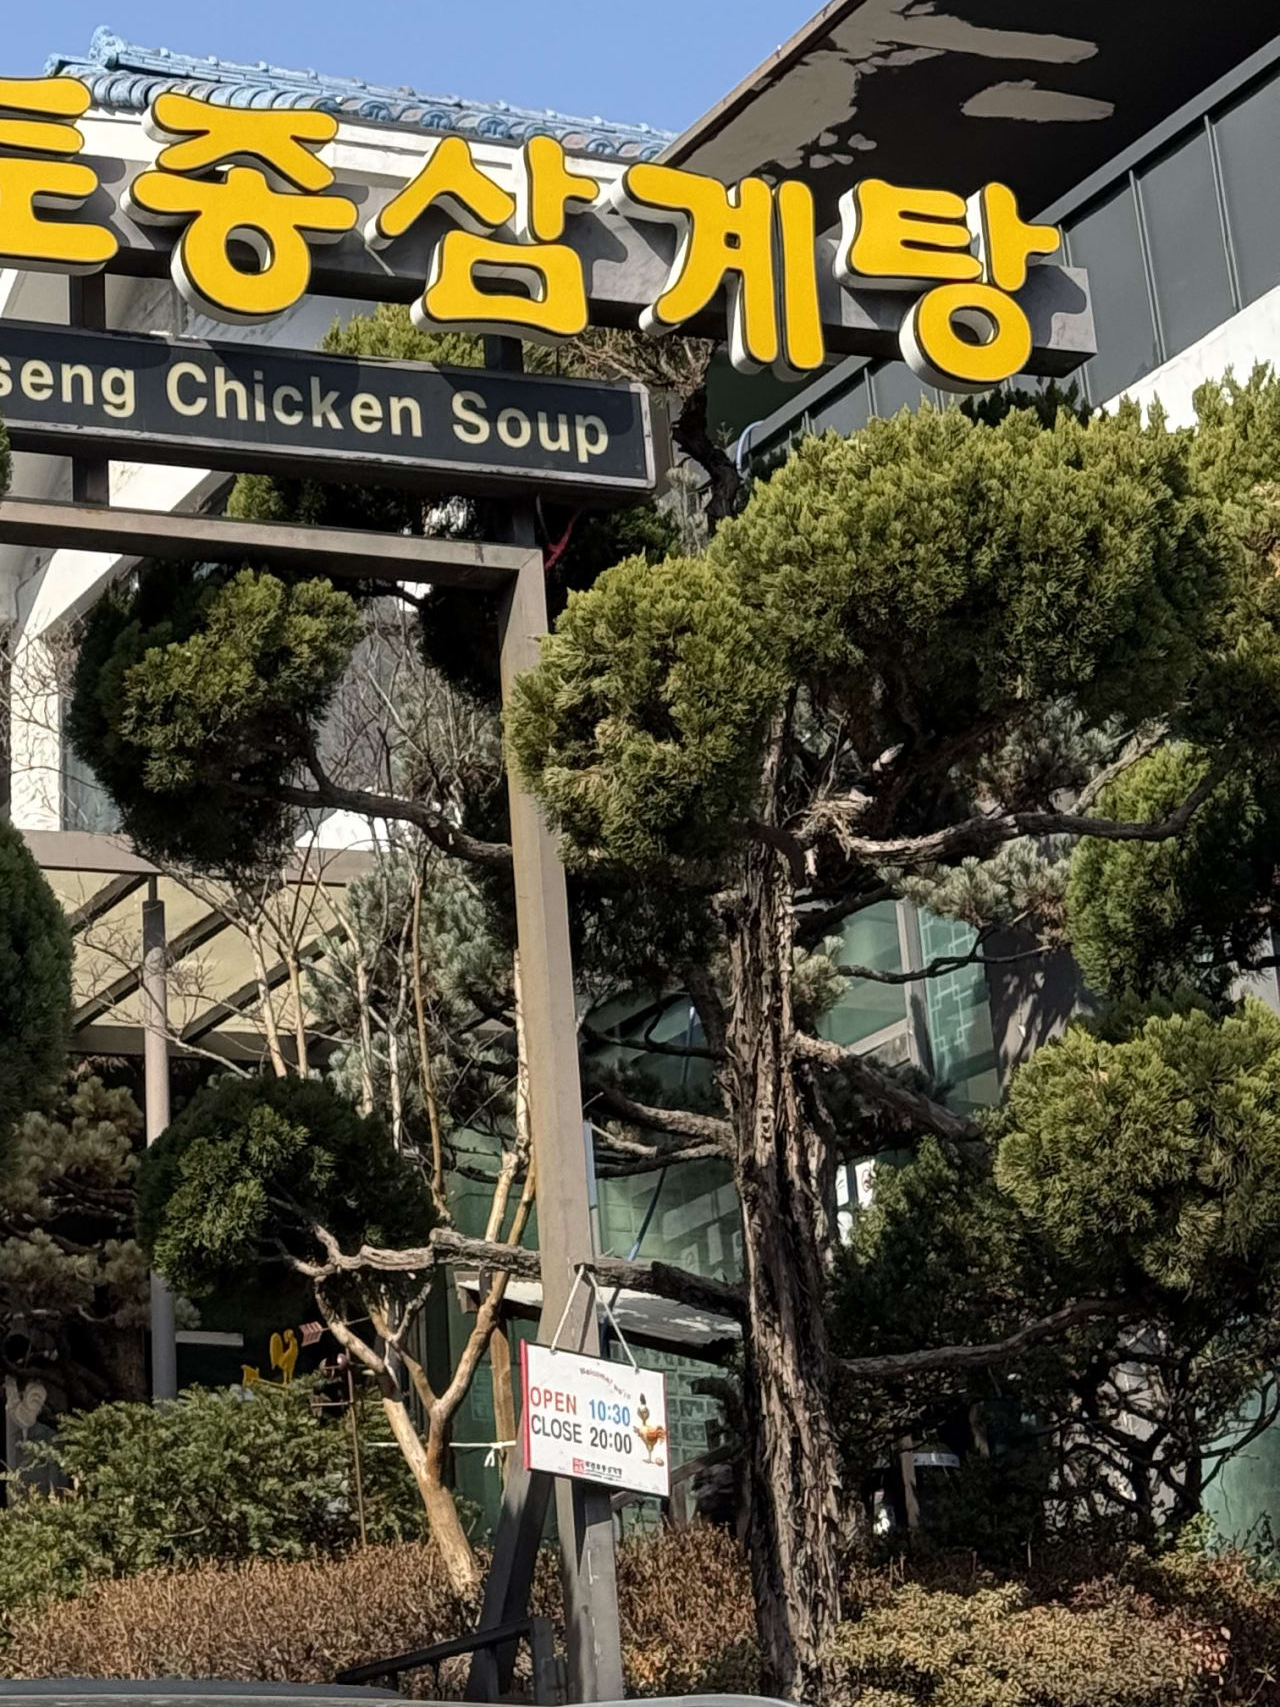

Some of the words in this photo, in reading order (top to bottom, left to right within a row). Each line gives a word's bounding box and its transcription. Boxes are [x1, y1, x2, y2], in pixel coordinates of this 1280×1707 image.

[166, 361, 423, 438] Chicken
[452, 390, 609, 463] Soup
[530, 1386, 577, 1415] OPEN
[589, 1399, 631, 1427] 10:30
[531, 1414, 583, 1444] CLOSE
[590, 1427, 632, 1454] 20:00
